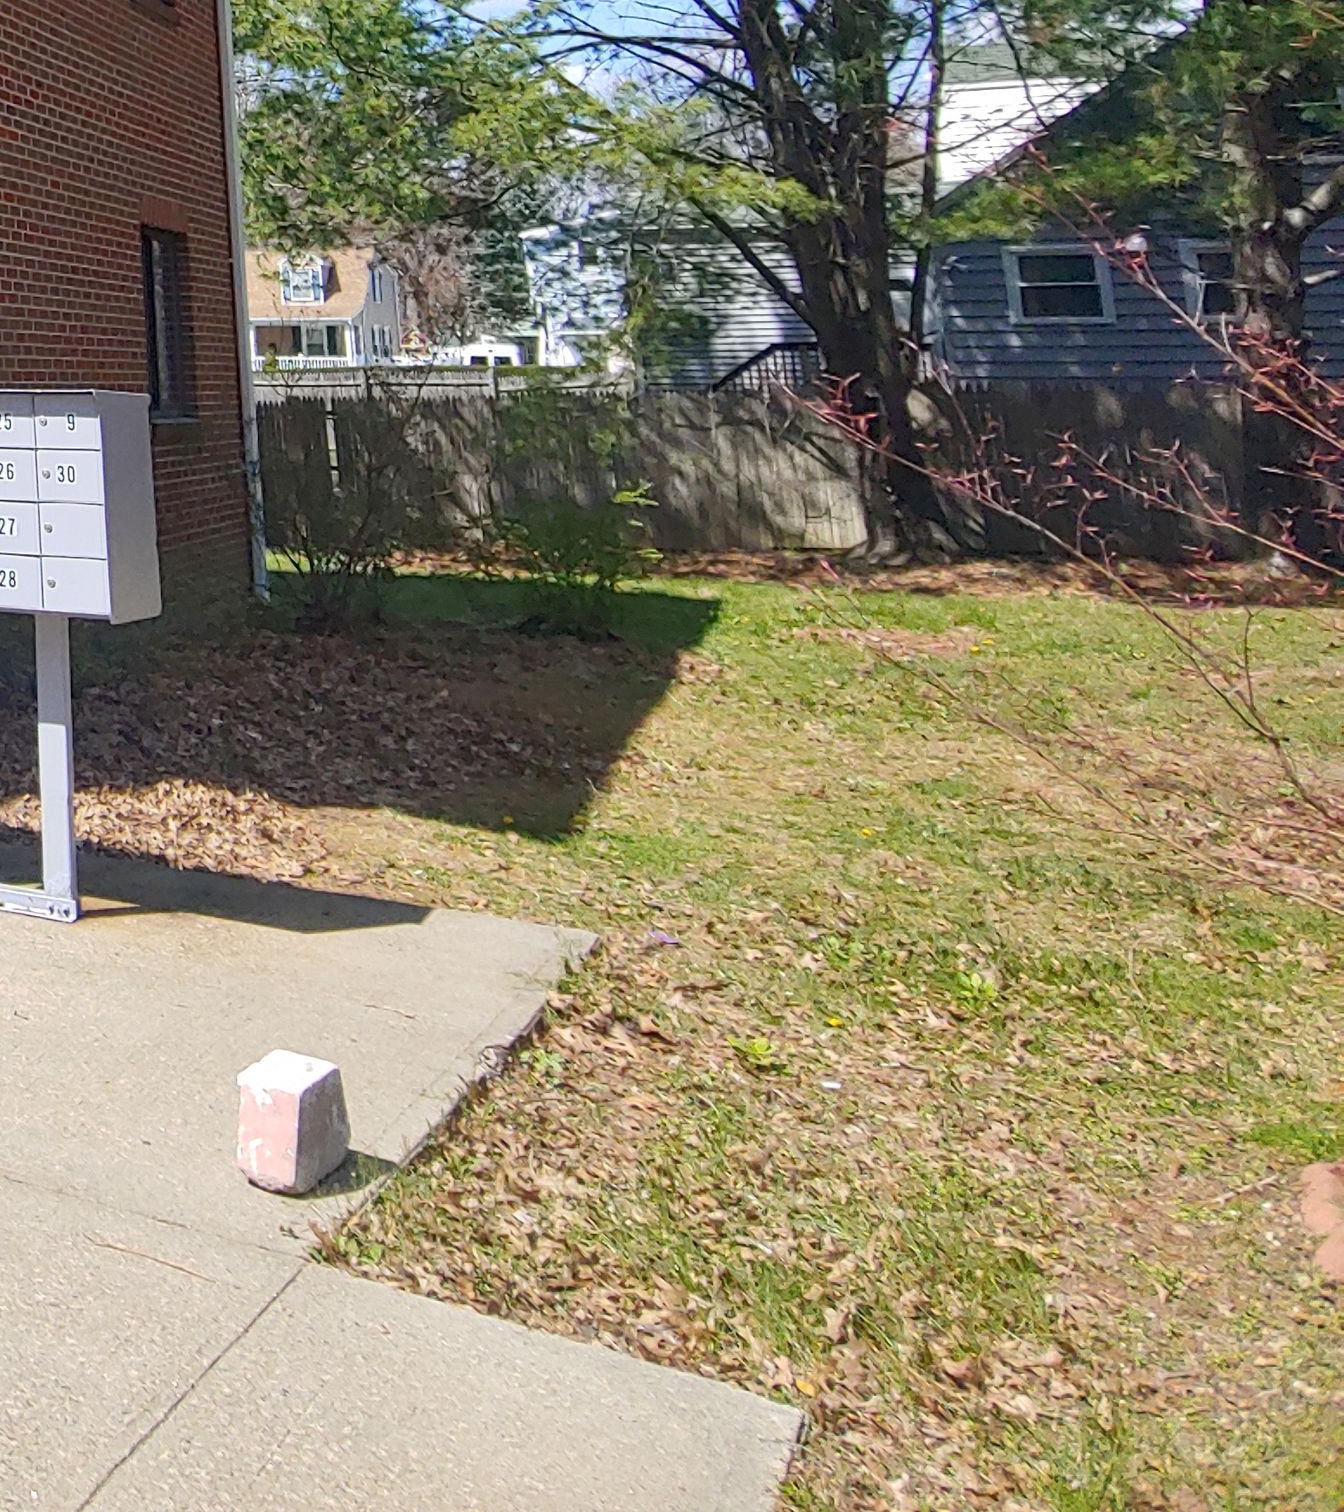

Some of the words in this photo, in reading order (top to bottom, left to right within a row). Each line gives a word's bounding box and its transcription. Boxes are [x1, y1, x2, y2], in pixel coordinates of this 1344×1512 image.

[66, 413, 77, 431] 9
[57, 465, 76, 483] 30
[0, 569, 17, 588] 28
